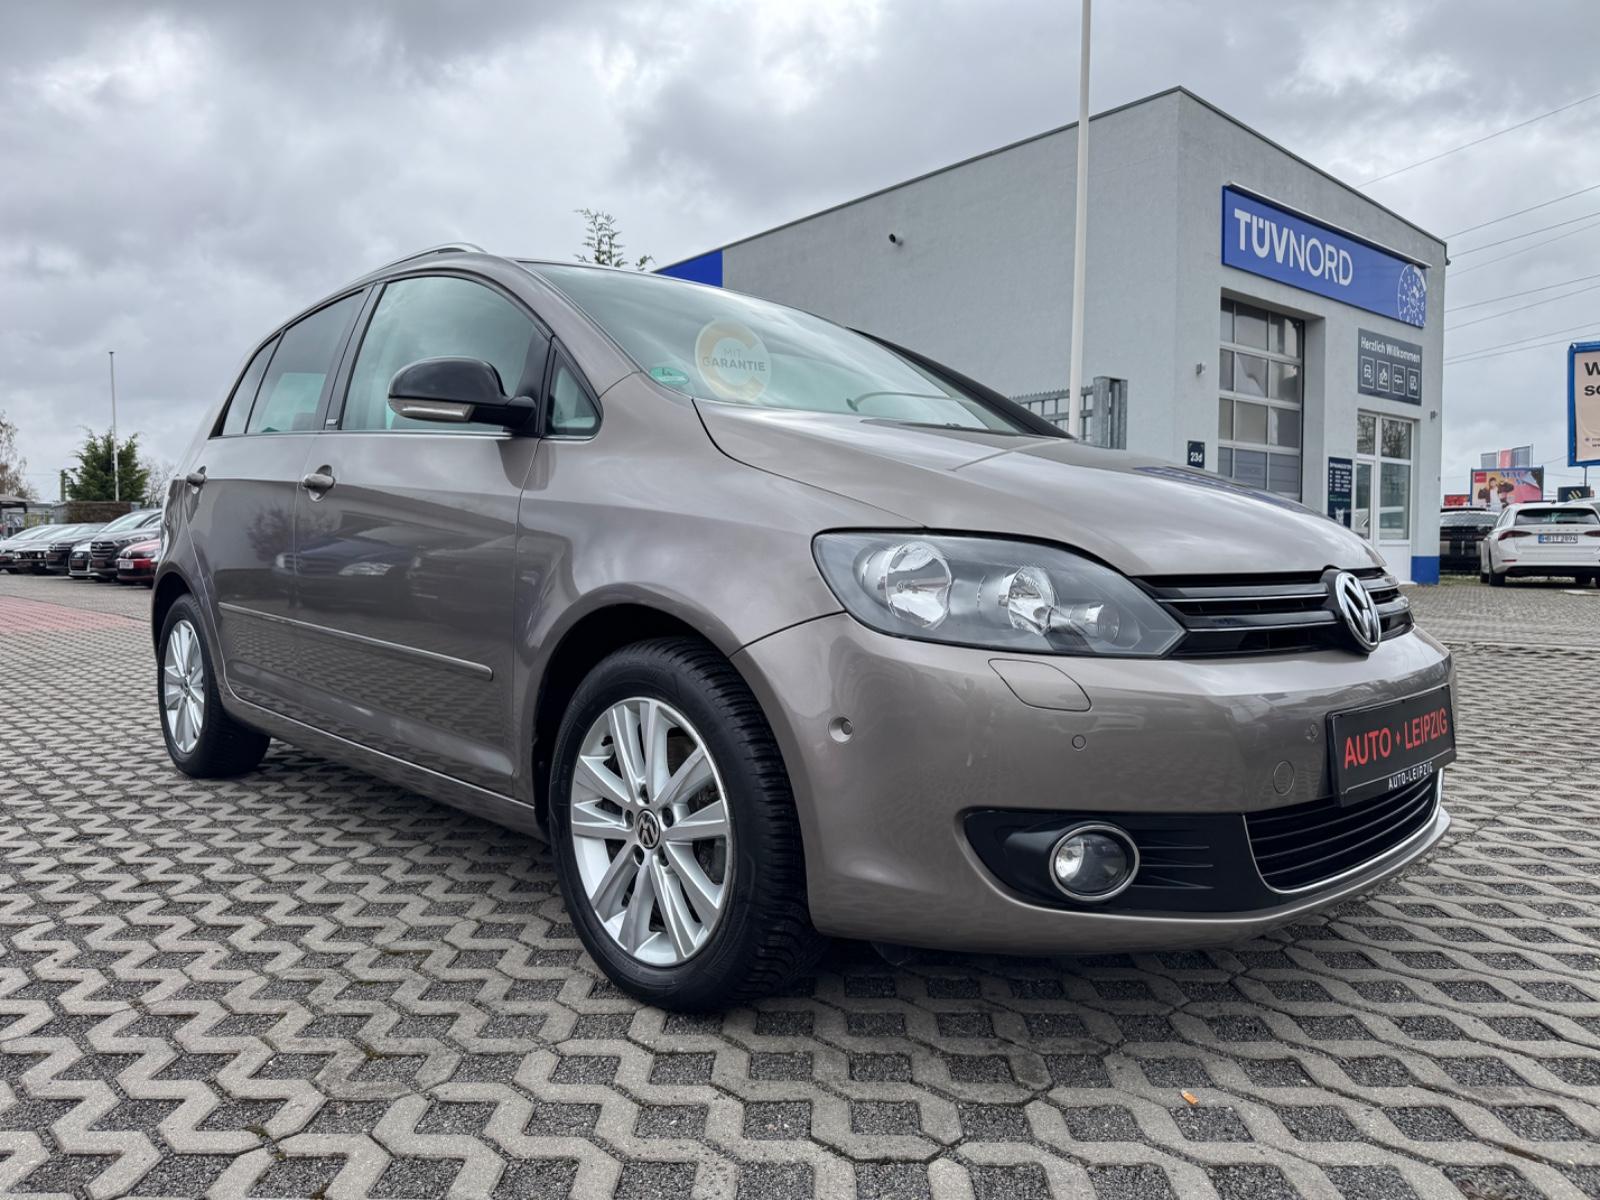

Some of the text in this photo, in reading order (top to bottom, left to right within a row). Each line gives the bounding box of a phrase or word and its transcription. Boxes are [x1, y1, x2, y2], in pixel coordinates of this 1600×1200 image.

[1234, 208, 1353, 286] TÜVNORD
[724, 348, 742, 356] MIT
[1360, 336, 1421, 363] Herzlich Willkommen
[702, 356, 766, 372] GARANTIE
[1344, 708, 1447, 769] AUTO LEIPZIG
[1388, 762, 1433, 790] AUTO-LEIPZIG
